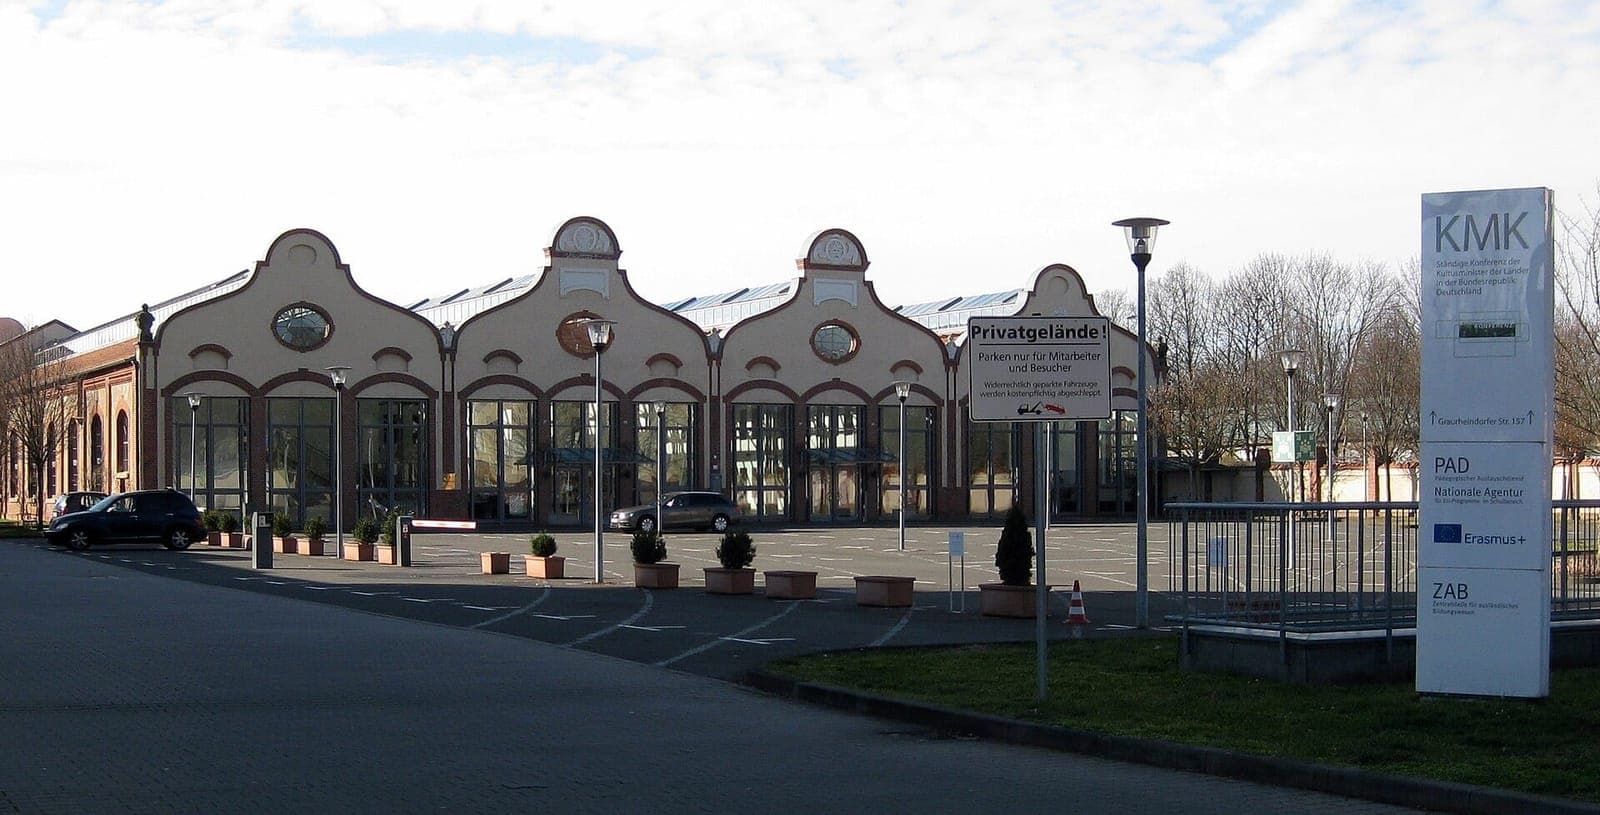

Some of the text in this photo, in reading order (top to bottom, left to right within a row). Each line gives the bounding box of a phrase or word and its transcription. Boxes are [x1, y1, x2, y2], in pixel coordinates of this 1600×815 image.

[1435, 211, 1529, 253] KMK
[1436, 287, 1482, 297] Deutschland
[979, 351, 1101, 361] Parken nur für Mitarbeiter
[1008, 363, 1072, 373] und Besucher
[1438, 417, 1525, 426] Graurheindorfer Str. 157
[1435, 457, 1470, 474] PAD
[1434, 487, 1524, 499] Nationale Agentur
[1464, 533, 1526, 545] Erasmus+
[1433, 582, 1469, 600] ZAB
